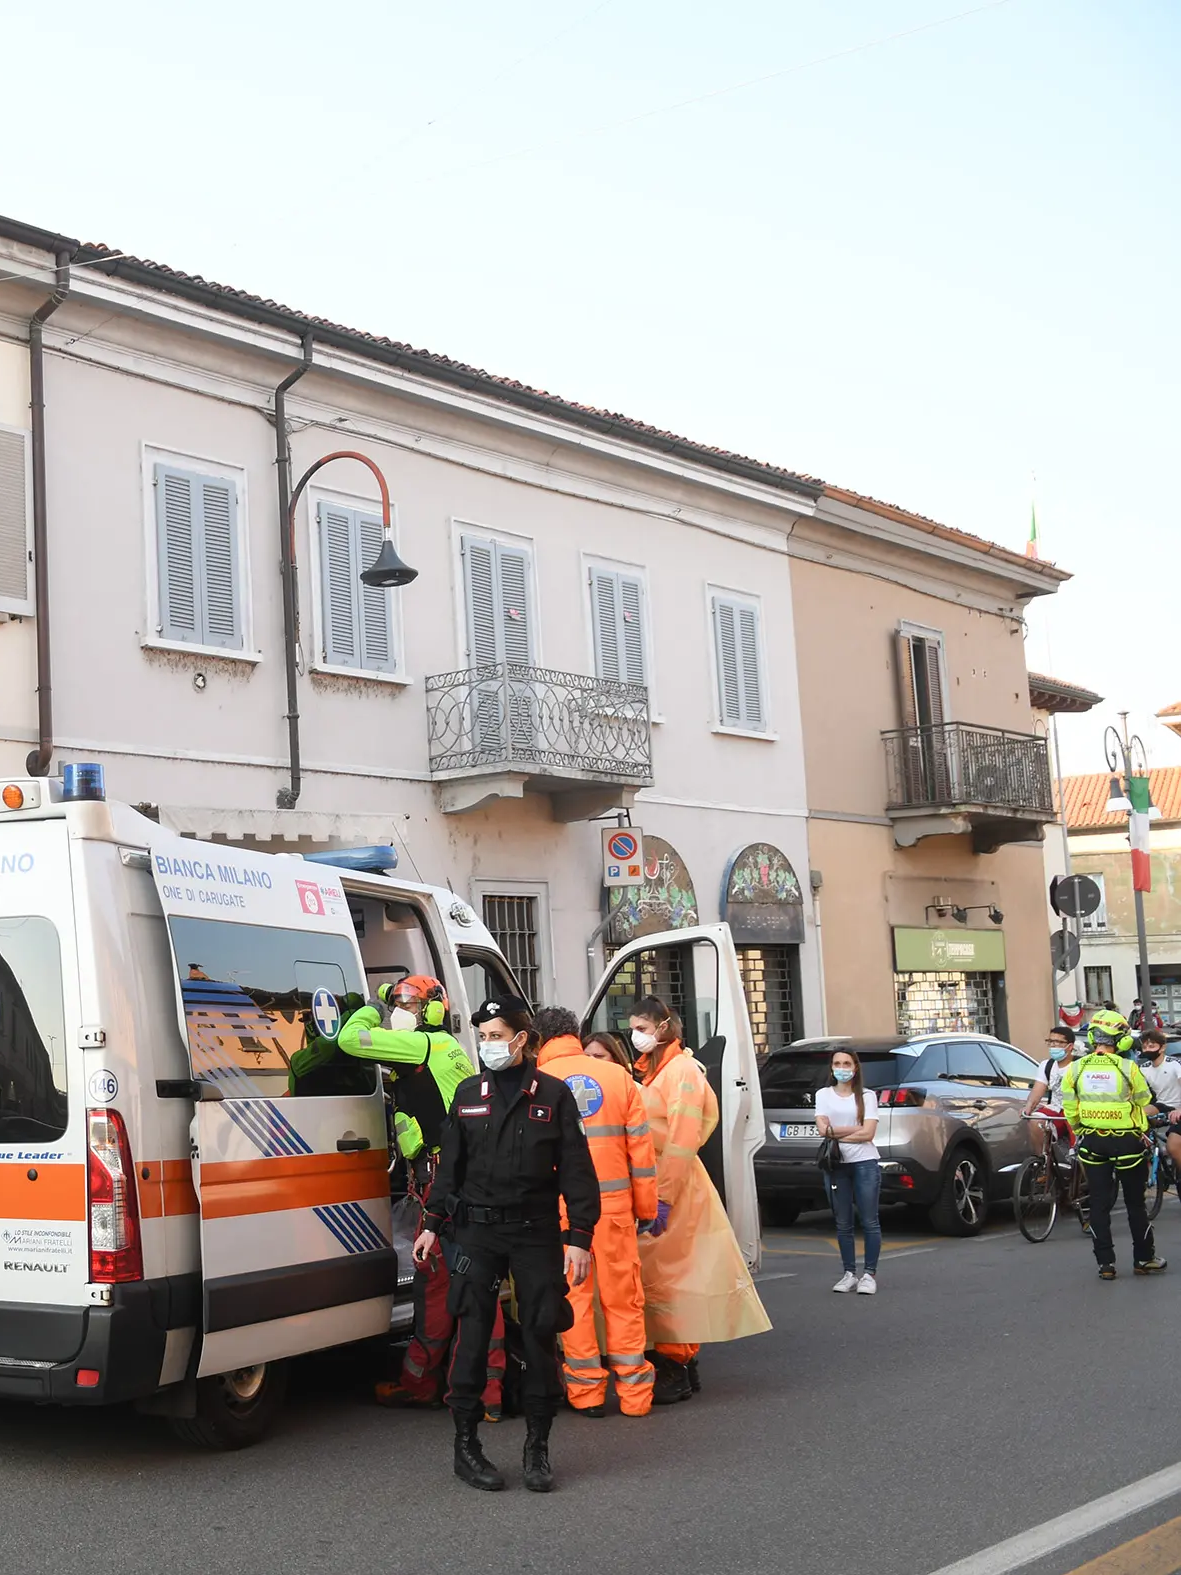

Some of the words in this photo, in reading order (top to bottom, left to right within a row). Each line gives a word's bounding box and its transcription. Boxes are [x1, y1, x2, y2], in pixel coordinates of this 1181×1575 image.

[155, 855, 217, 881] BIANCA
[219, 865, 273, 889] MILANO
[186, 888, 196, 901] DI
[199, 890, 247, 908] CARUGATE
[91, 1078, 116, 1094] 146
[1081, 1109, 1123, 1120] ELISOCCORSO
[786, 1125, 800, 1136] GB
[17, 1151, 65, 1160] Leader
[3, 1260, 71, 1274] RENAULT
